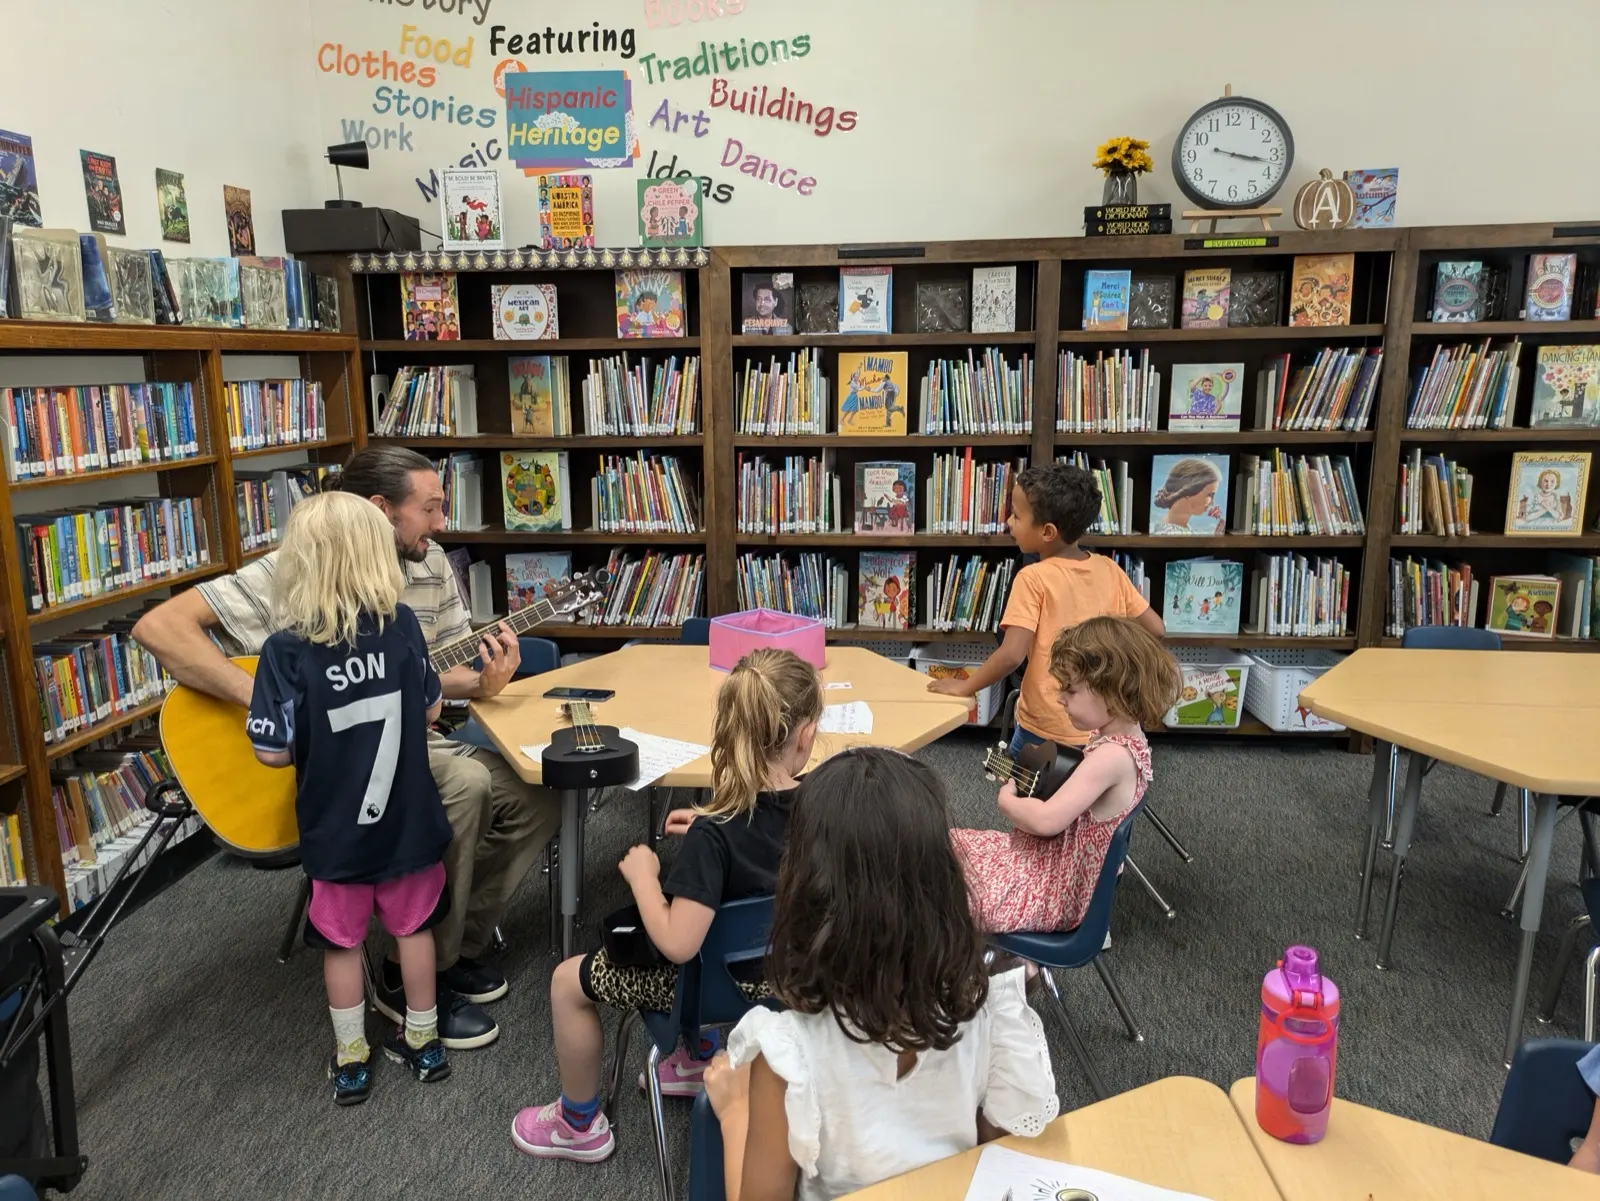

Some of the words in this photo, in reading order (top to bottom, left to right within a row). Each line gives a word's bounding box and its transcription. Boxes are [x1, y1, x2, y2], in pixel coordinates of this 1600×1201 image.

[400, 24, 475, 69] Food
[489, 22, 636, 59] Featuring
[318, 42, 437, 88] Clothes
[639, 34, 812, 85] Traditions
[372, 86, 498, 129] Stories
[506, 86, 618, 116] Hispanic
[709, 77, 859, 137] Buildings
[649, 98, 711, 138] Art
[1207, 118, 1221, 132] 11
[1224, 112, 1241, 127] 12
[1248, 117, 1256, 130] 1
[340, 118, 414, 152] Work
[508, 117, 620, 152] Heritage
[1194, 131, 1209, 146] 10
[1261, 130, 1272, 143] 2
[1187, 149, 1197, 163] 9
[1269, 147, 1280, 162] 3
[415, 138, 503, 204] Msic
[720, 137, 818, 196] Dance
[1261, 166, 1272, 180] 4
[1193, 168, 1204, 182] 8
[1207, 180, 1218, 194] 7
[1227, 185, 1238, 199] 6
[1247, 180, 1257, 194] 5
[647, 199, 665, 207] CHILE
[1105, 206, 1129, 214] WORLD
[1308, 187, 1342, 223] A
[1105, 211, 1149, 220] DICTIONARY
[1106, 221, 1130, 229] WORLD
[1106, 227, 1150, 235] DICTIONARY
[1211, 239, 1258, 247] EVERYBODY
[1101, 282, 1120, 290] Merci
[507, 298, 540, 306] Mexican
[1542, 352, 1580, 364] DANCING
[859, 390, 886, 410] MAMBO!
[1518, 455, 1534, 465] My
[872, 565, 894, 579] Wolf
[325, 652, 386, 692] SON
[326, 689, 402, 825] 7
